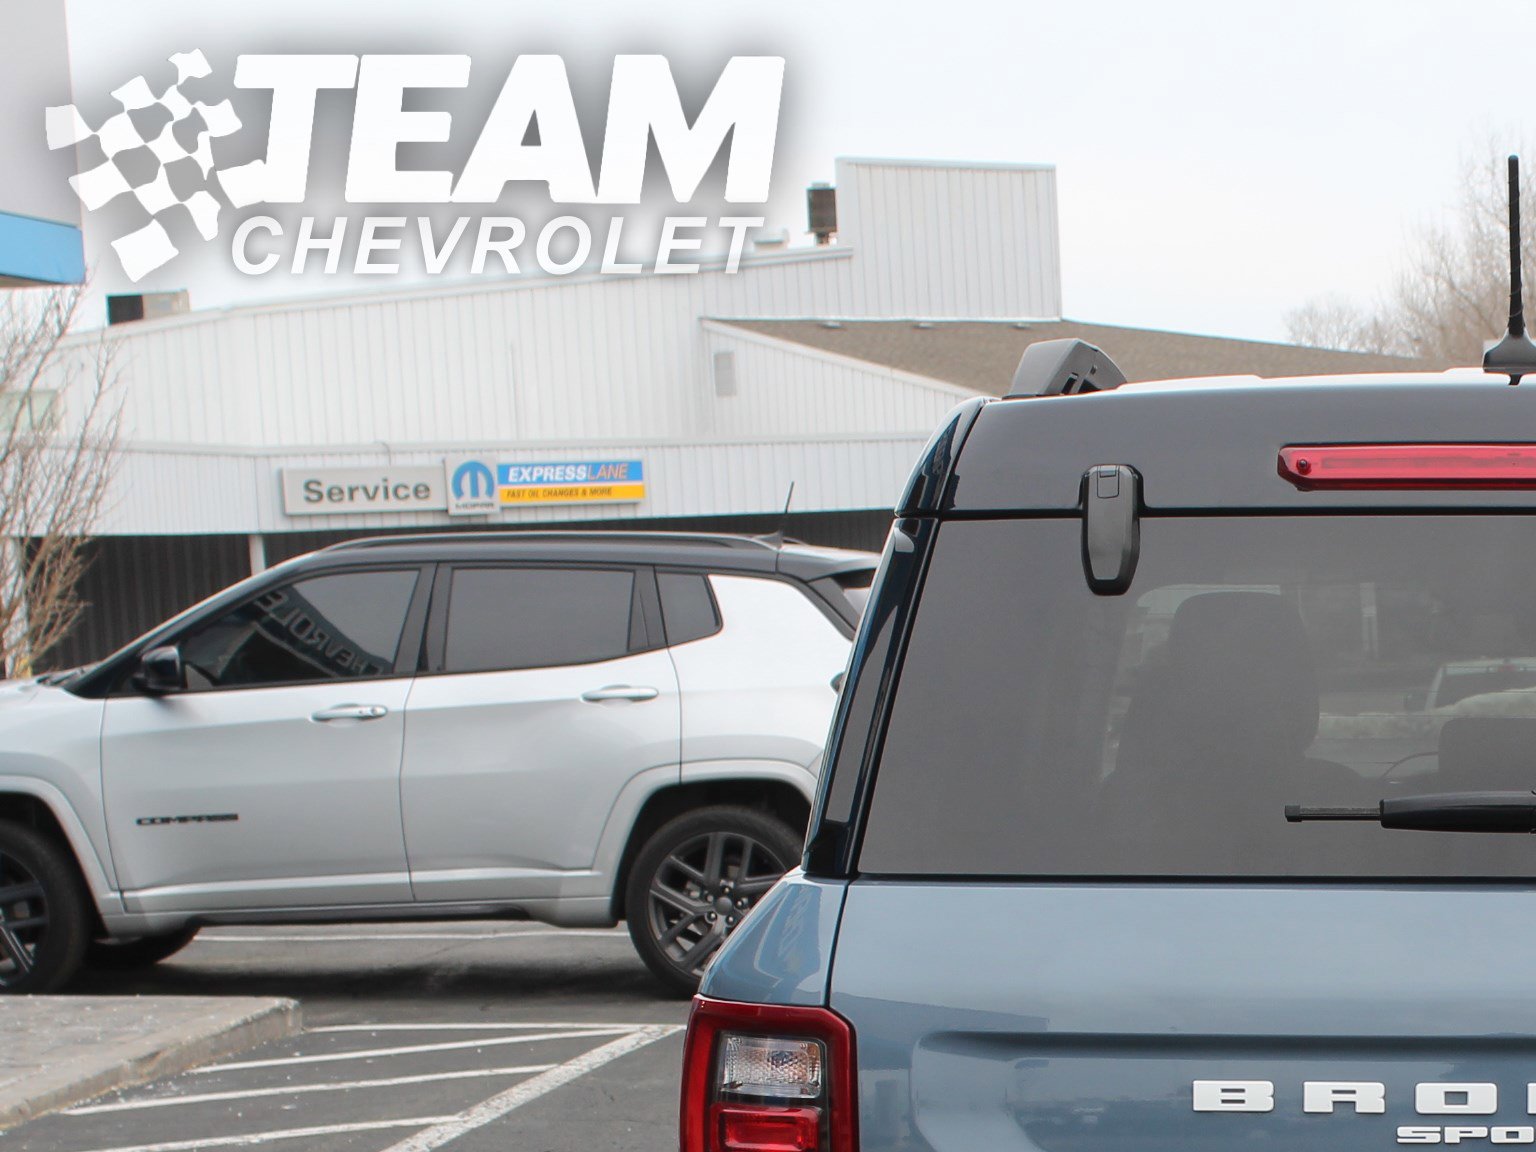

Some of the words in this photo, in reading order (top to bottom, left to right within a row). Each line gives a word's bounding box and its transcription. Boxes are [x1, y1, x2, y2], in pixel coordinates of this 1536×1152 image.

[303, 478, 431, 502] Service
[506, 489, 525, 498] FAST
[528, 488, 539, 498] OIL
[542, 488, 578, 498] CHANGES
[590, 487, 612, 496] MORE
[136, 813, 239, 826] COMPASS
